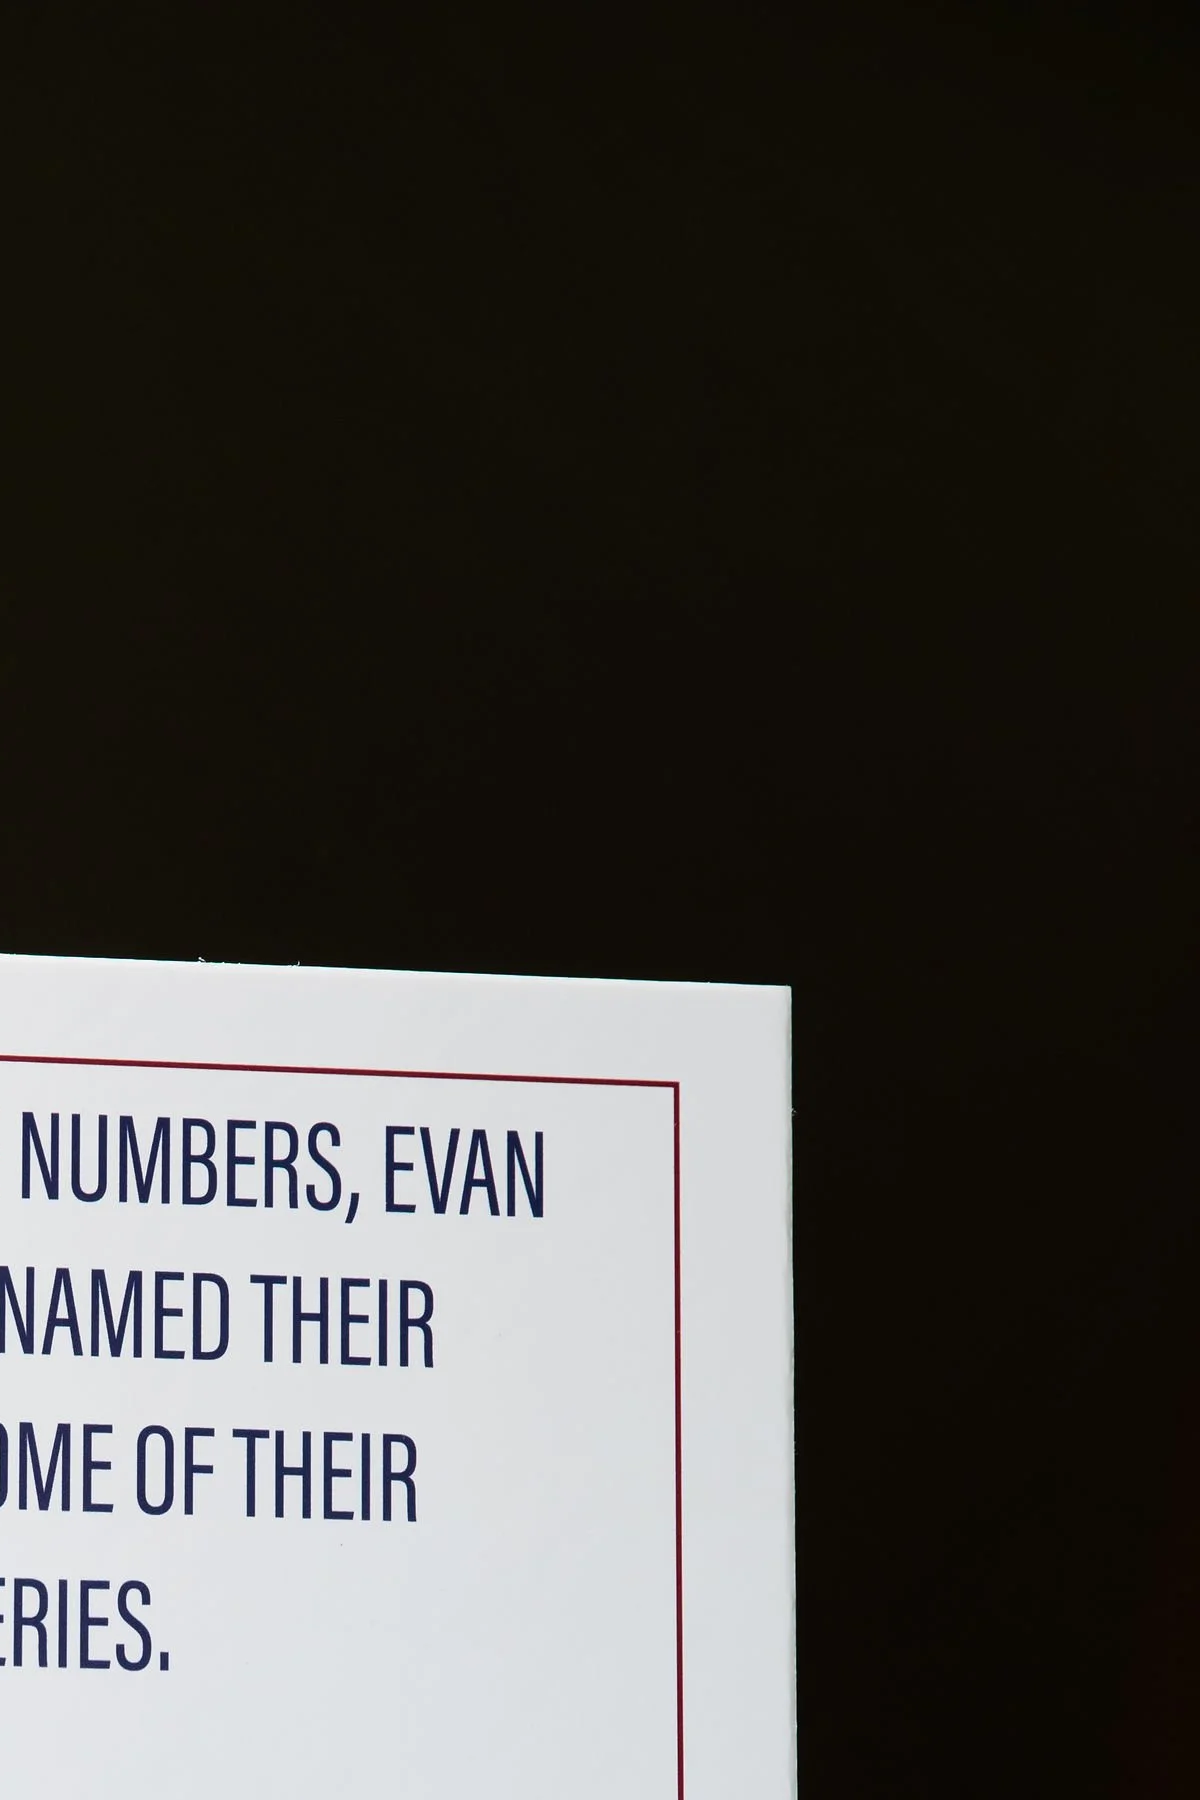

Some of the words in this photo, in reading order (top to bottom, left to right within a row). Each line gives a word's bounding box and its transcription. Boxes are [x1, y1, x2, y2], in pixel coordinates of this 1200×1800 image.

[20, 1110, 361, 1225] NUMBERS,
[384, 1124, 545, 1219] EVAN
[248, 1273, 435, 1370] THEIR
[135, 1423, 216, 1517] OF
[231, 1427, 418, 1524] THEIR
